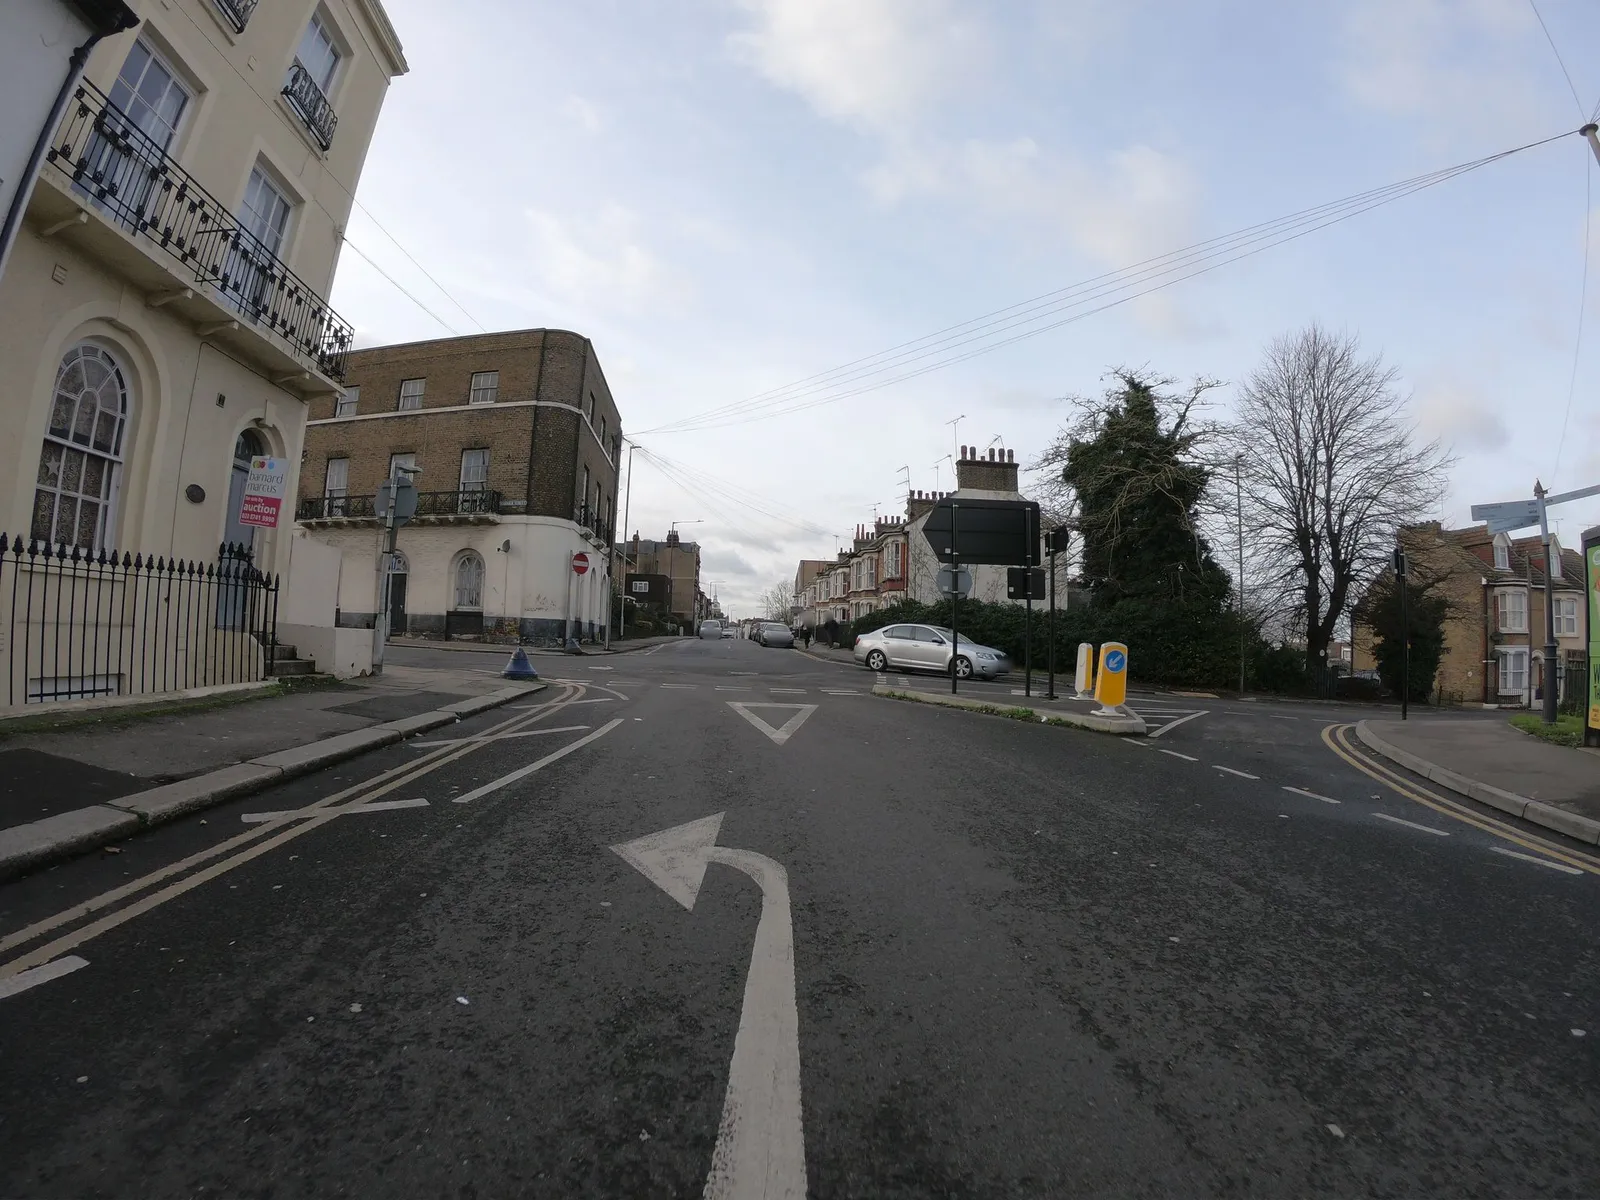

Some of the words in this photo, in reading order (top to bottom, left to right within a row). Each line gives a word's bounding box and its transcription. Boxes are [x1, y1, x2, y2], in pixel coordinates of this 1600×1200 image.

[250, 470, 284, 484] barnard
[247, 482, 277, 493] marcus
[243, 503, 276, 514] auction
